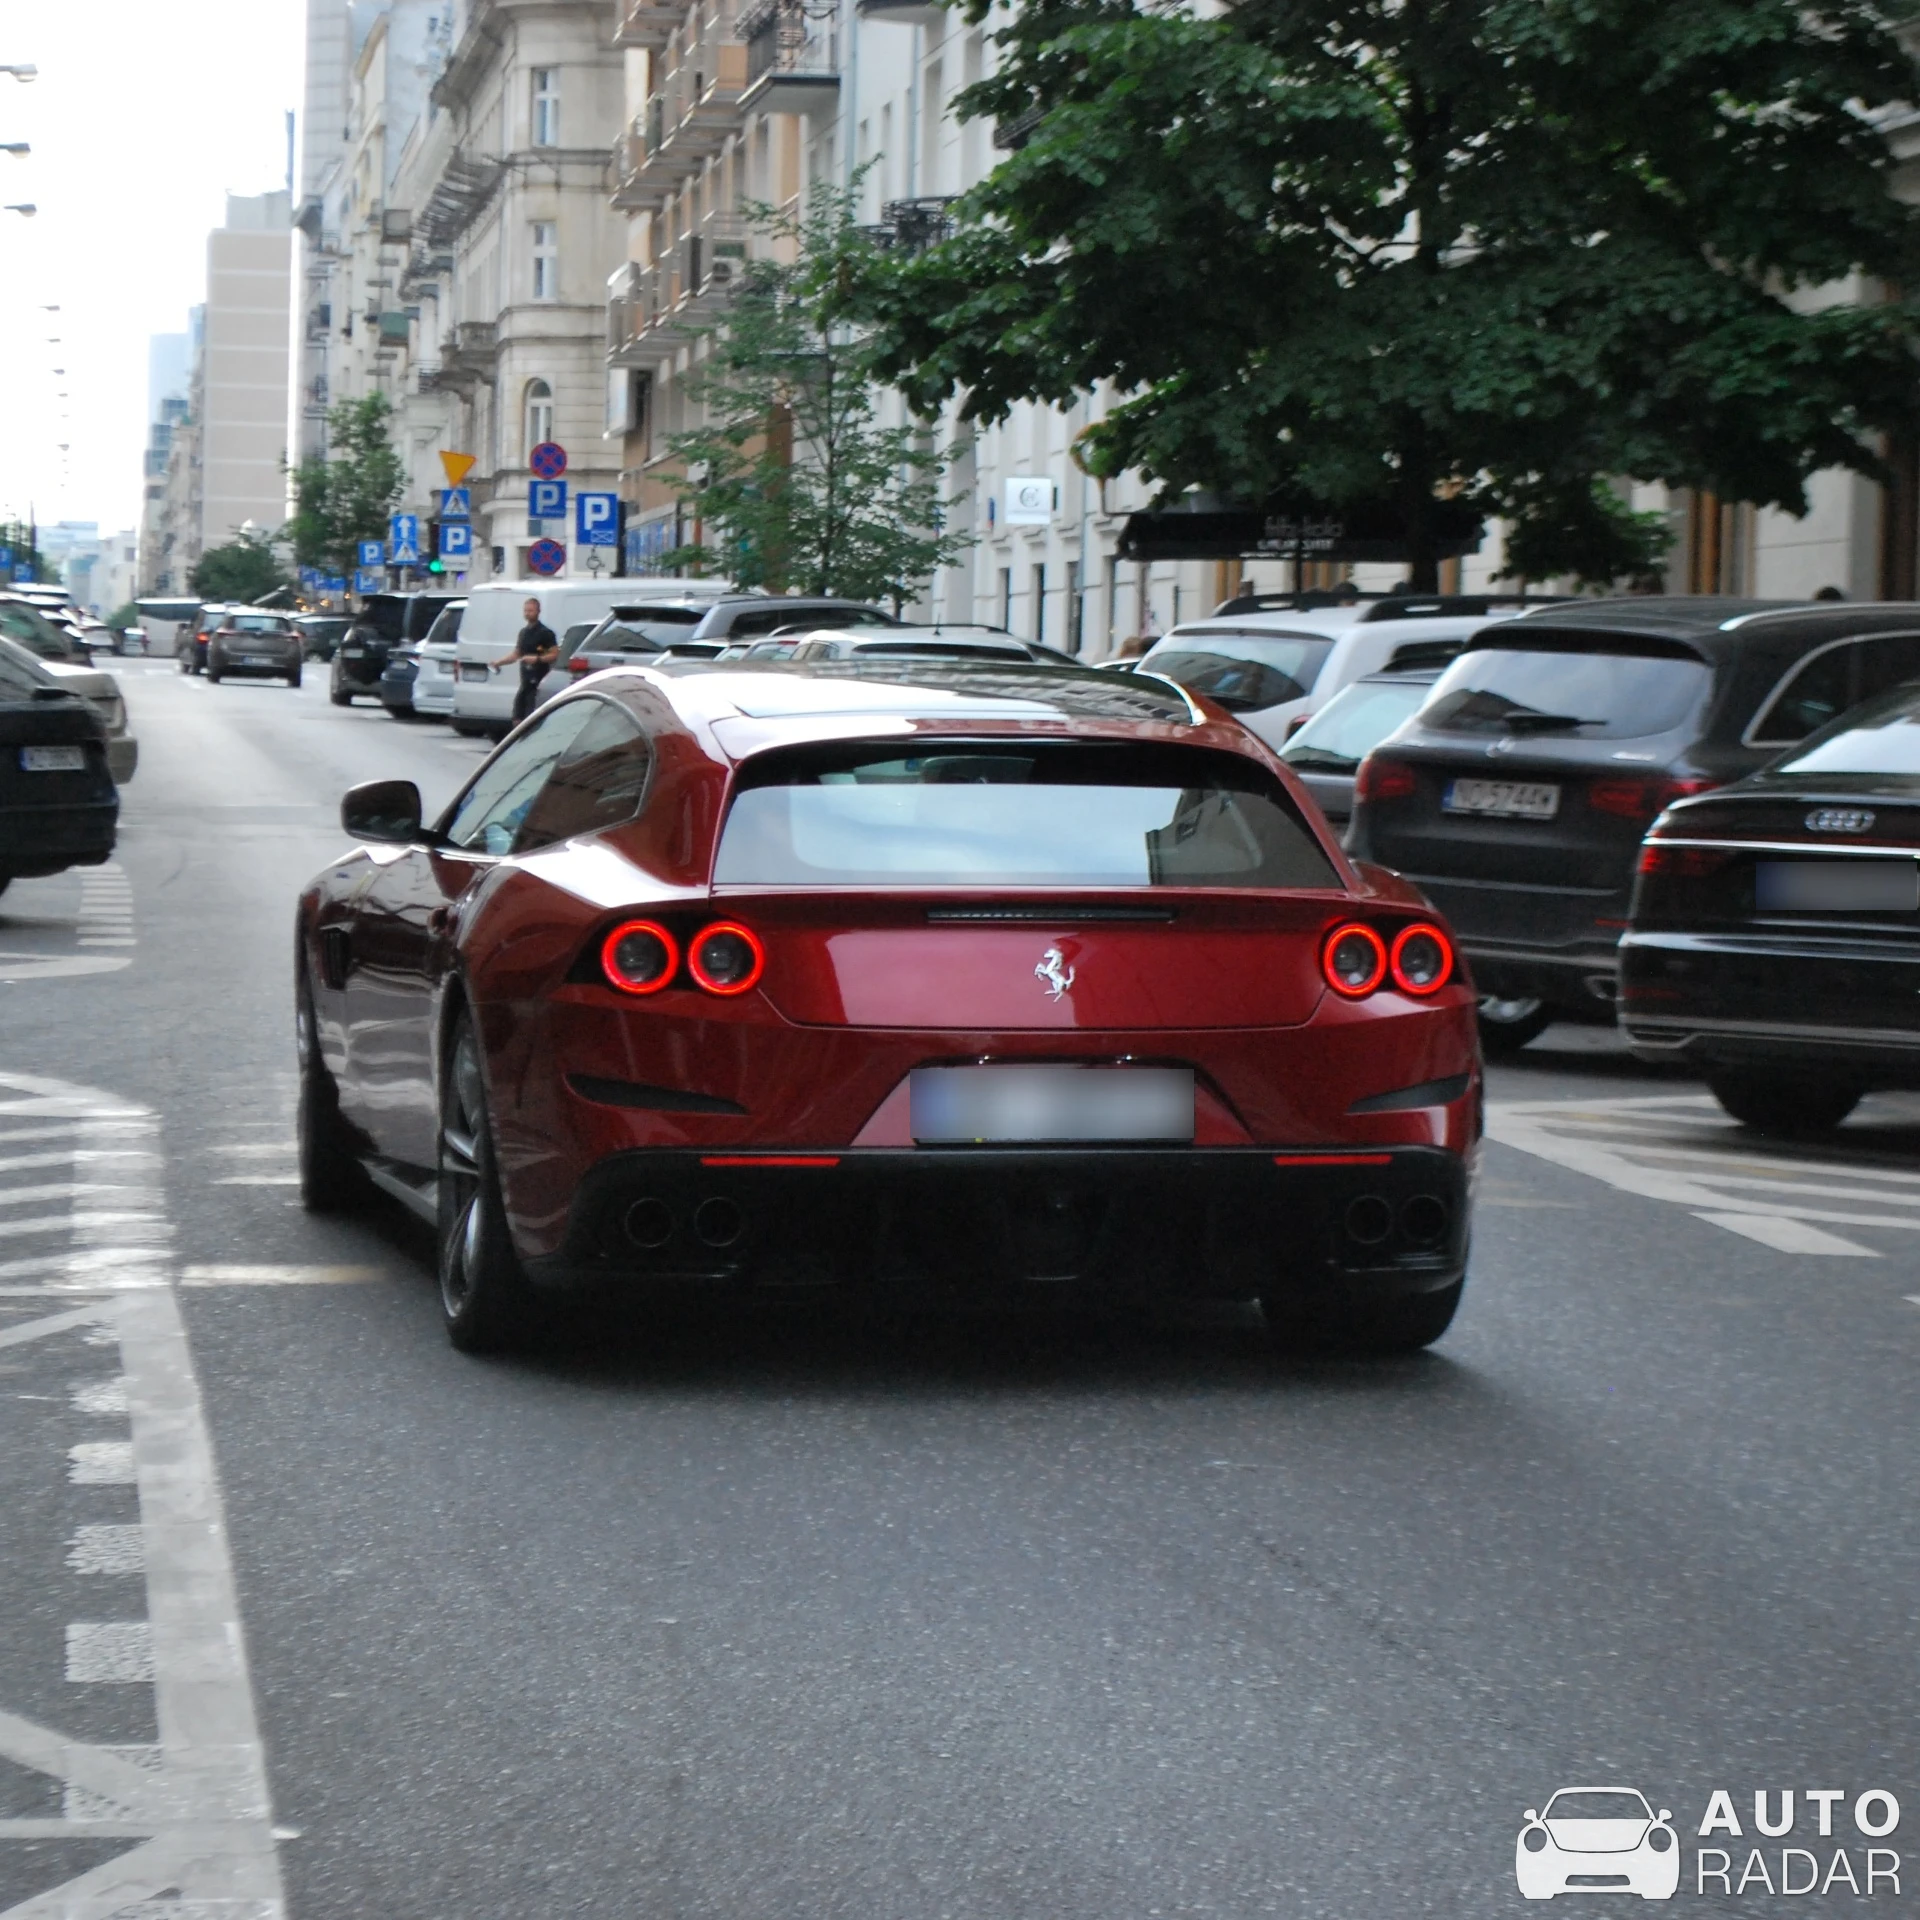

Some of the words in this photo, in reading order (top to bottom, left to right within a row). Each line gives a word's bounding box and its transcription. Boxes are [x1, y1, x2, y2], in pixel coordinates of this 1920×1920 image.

[536, 484, 559, 514] P
[584, 497, 610, 531] P
[446, 527, 466, 552] P
[364, 544, 378, 563] P
